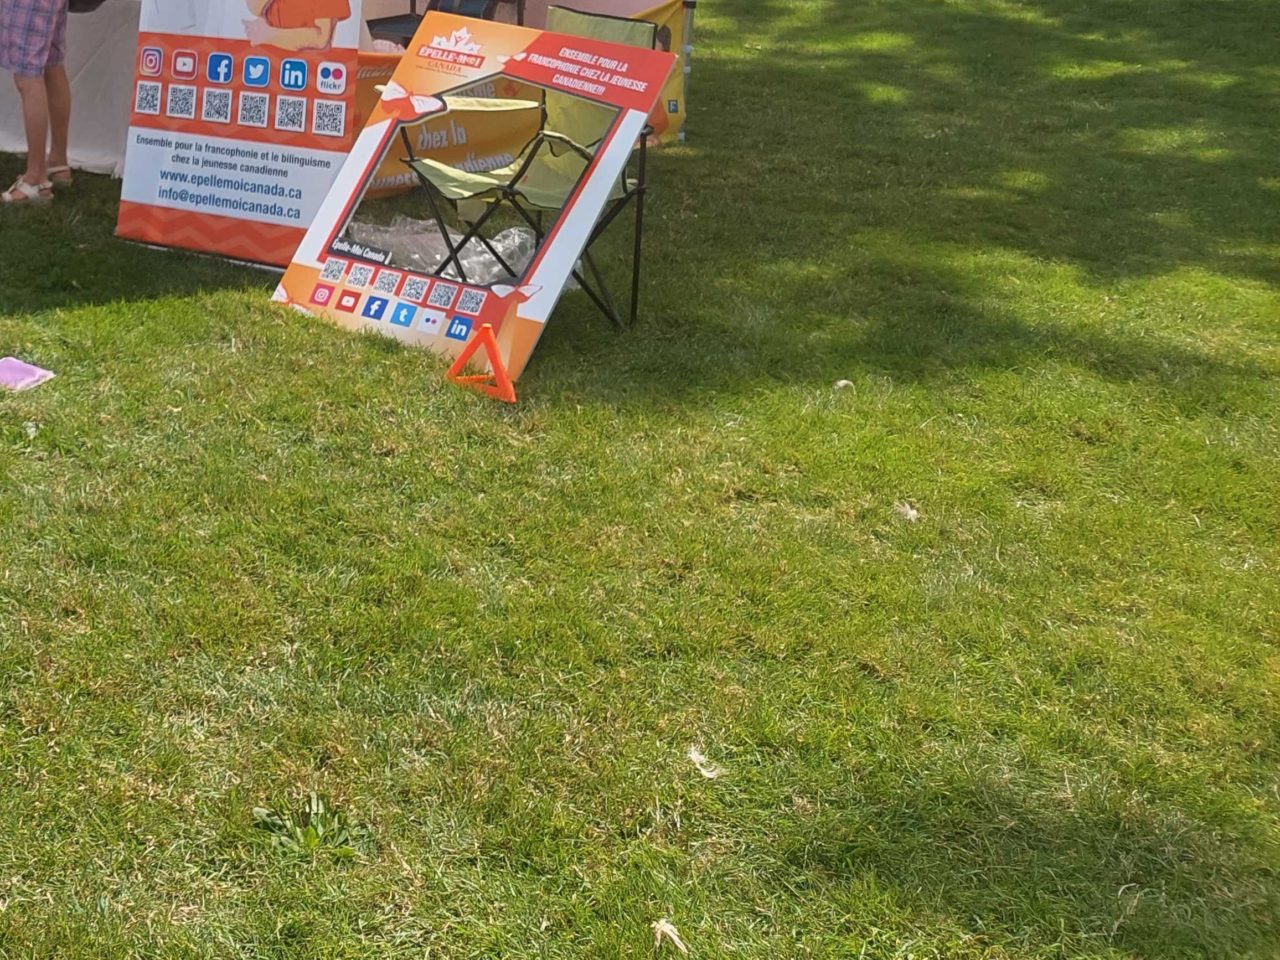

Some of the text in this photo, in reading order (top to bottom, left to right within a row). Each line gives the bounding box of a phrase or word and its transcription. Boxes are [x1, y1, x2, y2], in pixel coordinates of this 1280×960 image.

[527, 53, 648, 92] FRANCOPHONIE CHEZ LA JEUNESSE
[558, 47, 629, 73] ENSEMBLE POUR LA
[320, 80, 342, 90] flickr
[136, 134, 331, 169] Ensemble pour la francophonie et le bilinguisme
[171, 153, 289, 178] chez la jeunesse canadienne
[159, 169, 302, 200] www.epellemoicanada.ca
[158, 185, 301, 219] info@epellemoicanada.ca
